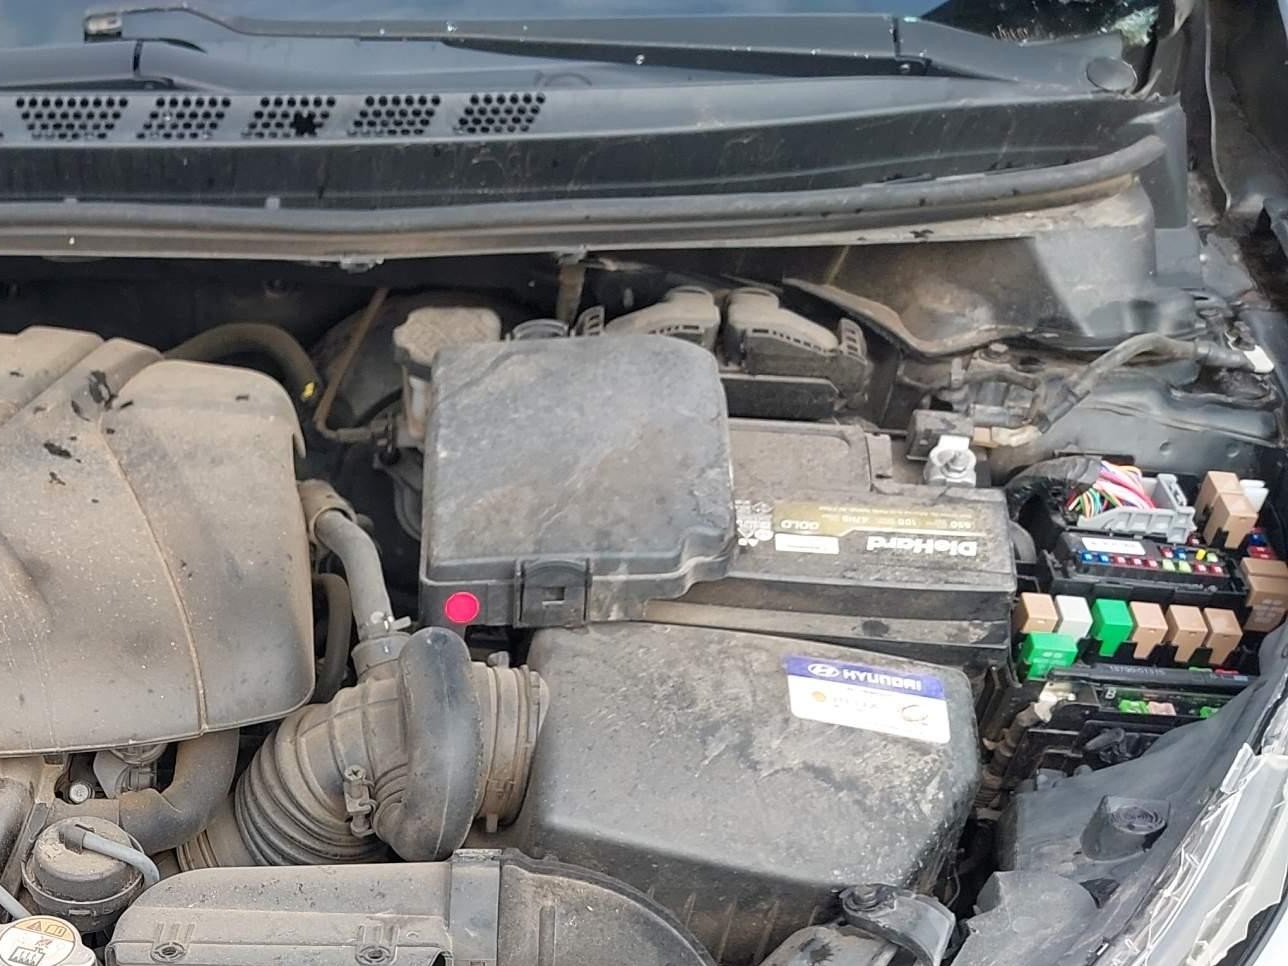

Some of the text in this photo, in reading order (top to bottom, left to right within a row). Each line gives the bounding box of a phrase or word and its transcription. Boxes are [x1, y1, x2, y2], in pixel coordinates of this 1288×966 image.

[780, 519, 820, 530] GOLD
[866, 536, 978, 557] DieHard
[842, 669, 922, 691] HYUNDAI
